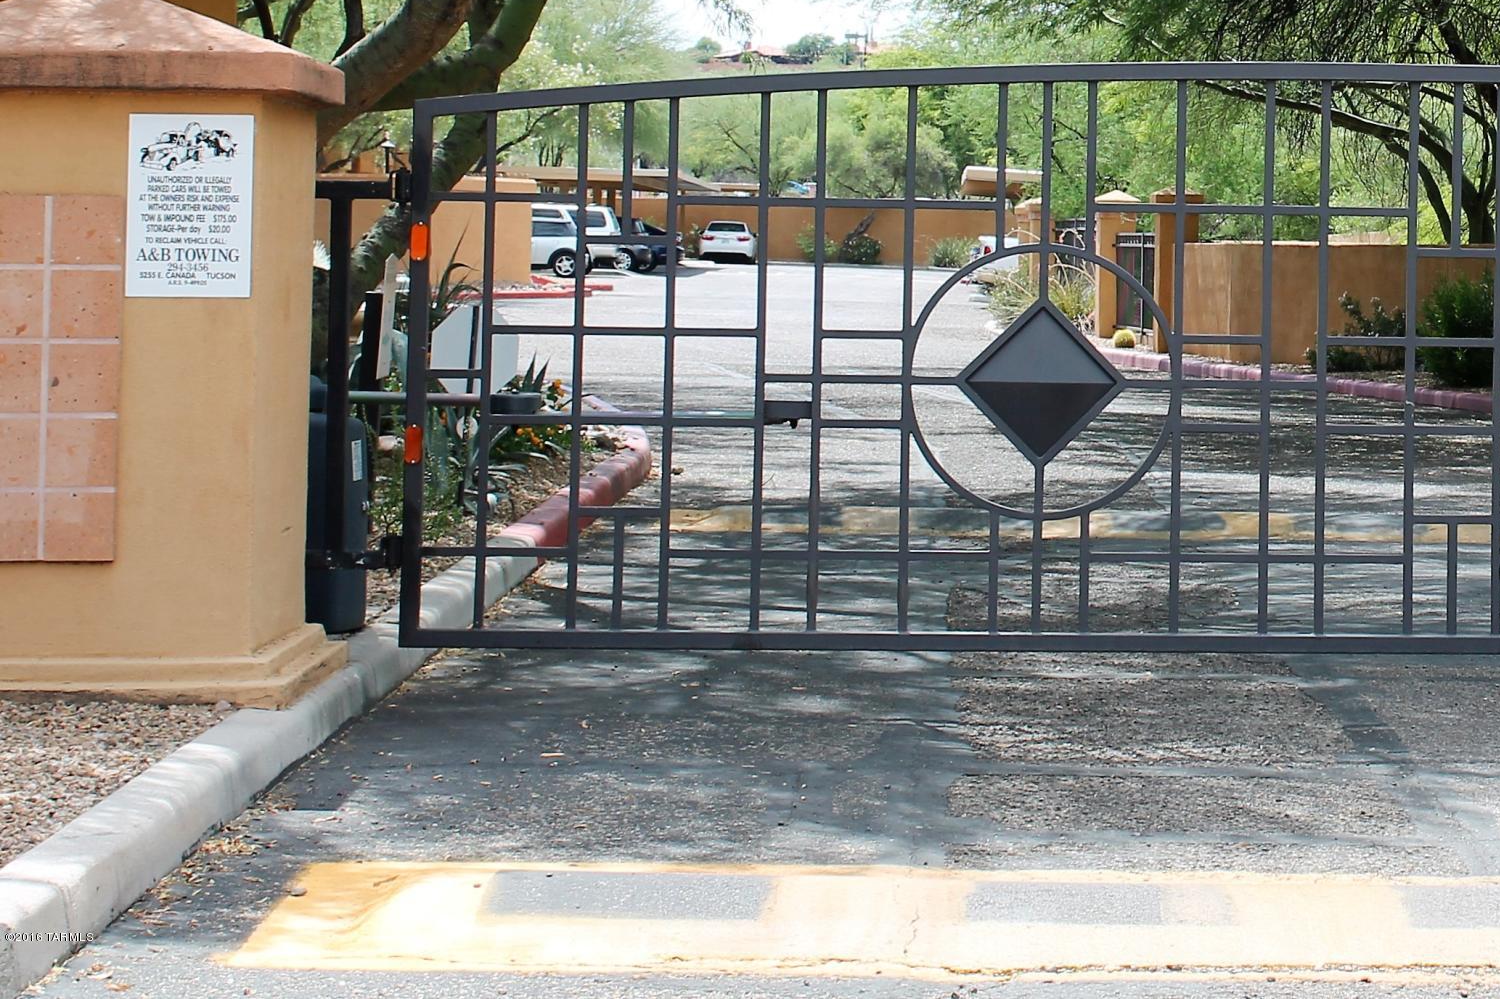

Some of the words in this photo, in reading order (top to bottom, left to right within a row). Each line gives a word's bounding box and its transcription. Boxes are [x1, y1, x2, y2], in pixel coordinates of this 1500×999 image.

[141, 214, 155, 222] TOW
[164, 214, 194, 222] IMPOUND
[190, 225, 201, 234] day
[209, 225, 230, 233] $20.00
[136, 248, 171, 262] A&B
[175, 248, 240, 262] TOWING
[168, 263, 209, 271] 294-3456
